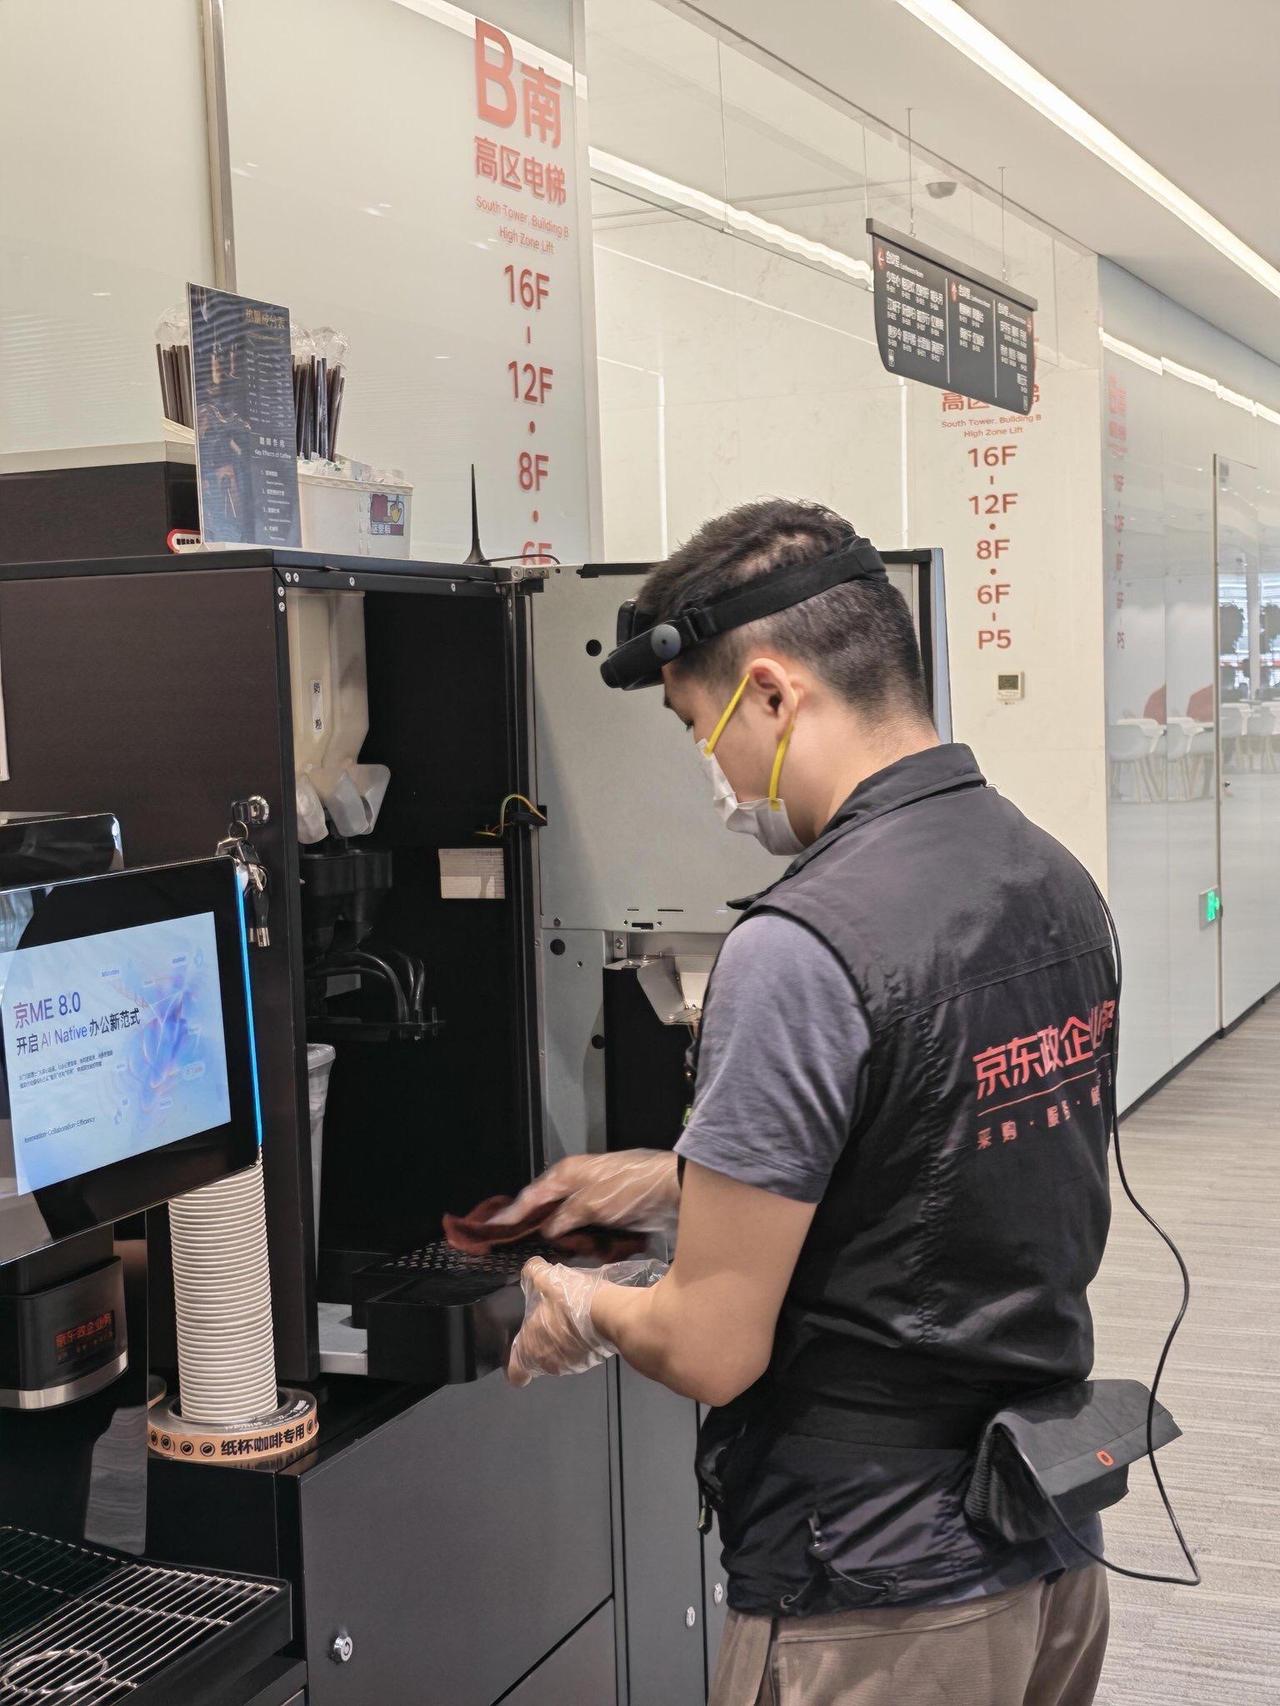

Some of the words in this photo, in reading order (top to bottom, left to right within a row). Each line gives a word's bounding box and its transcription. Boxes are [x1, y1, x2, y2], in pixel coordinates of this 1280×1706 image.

[475, 18, 562, 148] B南
[474, 135, 566, 206] 高区电梯
[476, 195, 501, 215] South
[531, 214, 563, 239] Building
[499, 226, 519, 246] High
[520, 232, 540, 249] Zone
[504, 264, 550, 310] 16F
[508, 360, 553, 404] 12F
[942, 419, 967, 429] South
[999, 414, 1034, 424] Building
[964, 429, 984, 438] High
[985, 429, 1007, 437] Zone
[519, 451, 550, 492] 8F
[967, 445, 1018, 468] 16F
[968, 493, 1019, 516] 12F
[976, 538, 1011, 560] 8F
[976, 584, 1011, 605] 6F
[977, 629, 1012, 650] P5
[13, 997, 55, 1030] 京ME
[58, 991, 82, 1017] 8.0
[16, 1032, 39, 1057] 开启
[41, 1031, 52, 1049] AI
[54, 1024, 88, 1046] Native
[89, 1007, 141, 1038] 办公新范式
[220, 1423, 306, 1458] 纸杯咖啡专用
